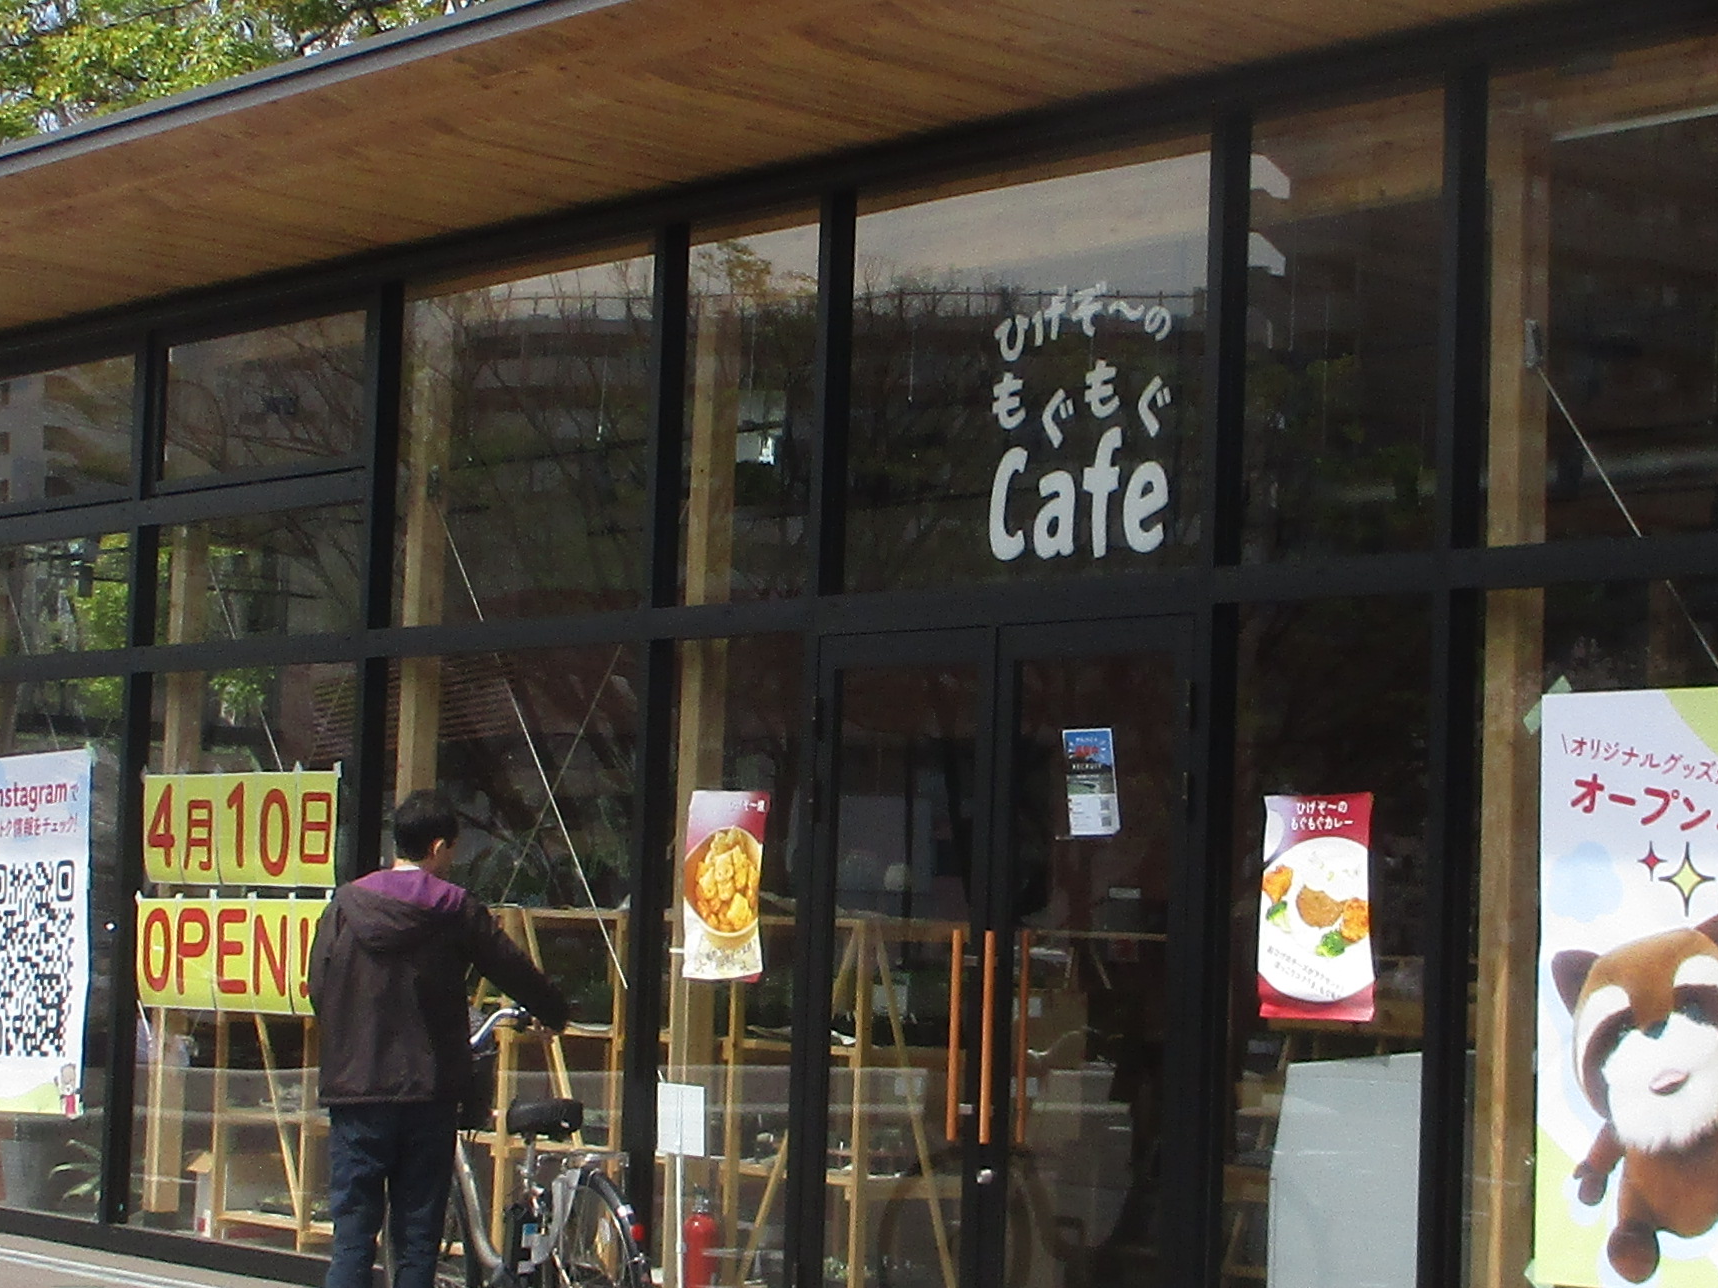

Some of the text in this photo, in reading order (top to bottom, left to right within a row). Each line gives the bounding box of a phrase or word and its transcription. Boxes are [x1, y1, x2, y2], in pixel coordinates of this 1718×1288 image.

[991, 359, 1173, 449] もぐもぐ
[988, 426, 1169, 561] Cafe
[147, 781, 332, 877] 4月10日
[1290, 816, 1354, 830] もぐもぐカレー
[143, 907, 321, 999] OPEN!
